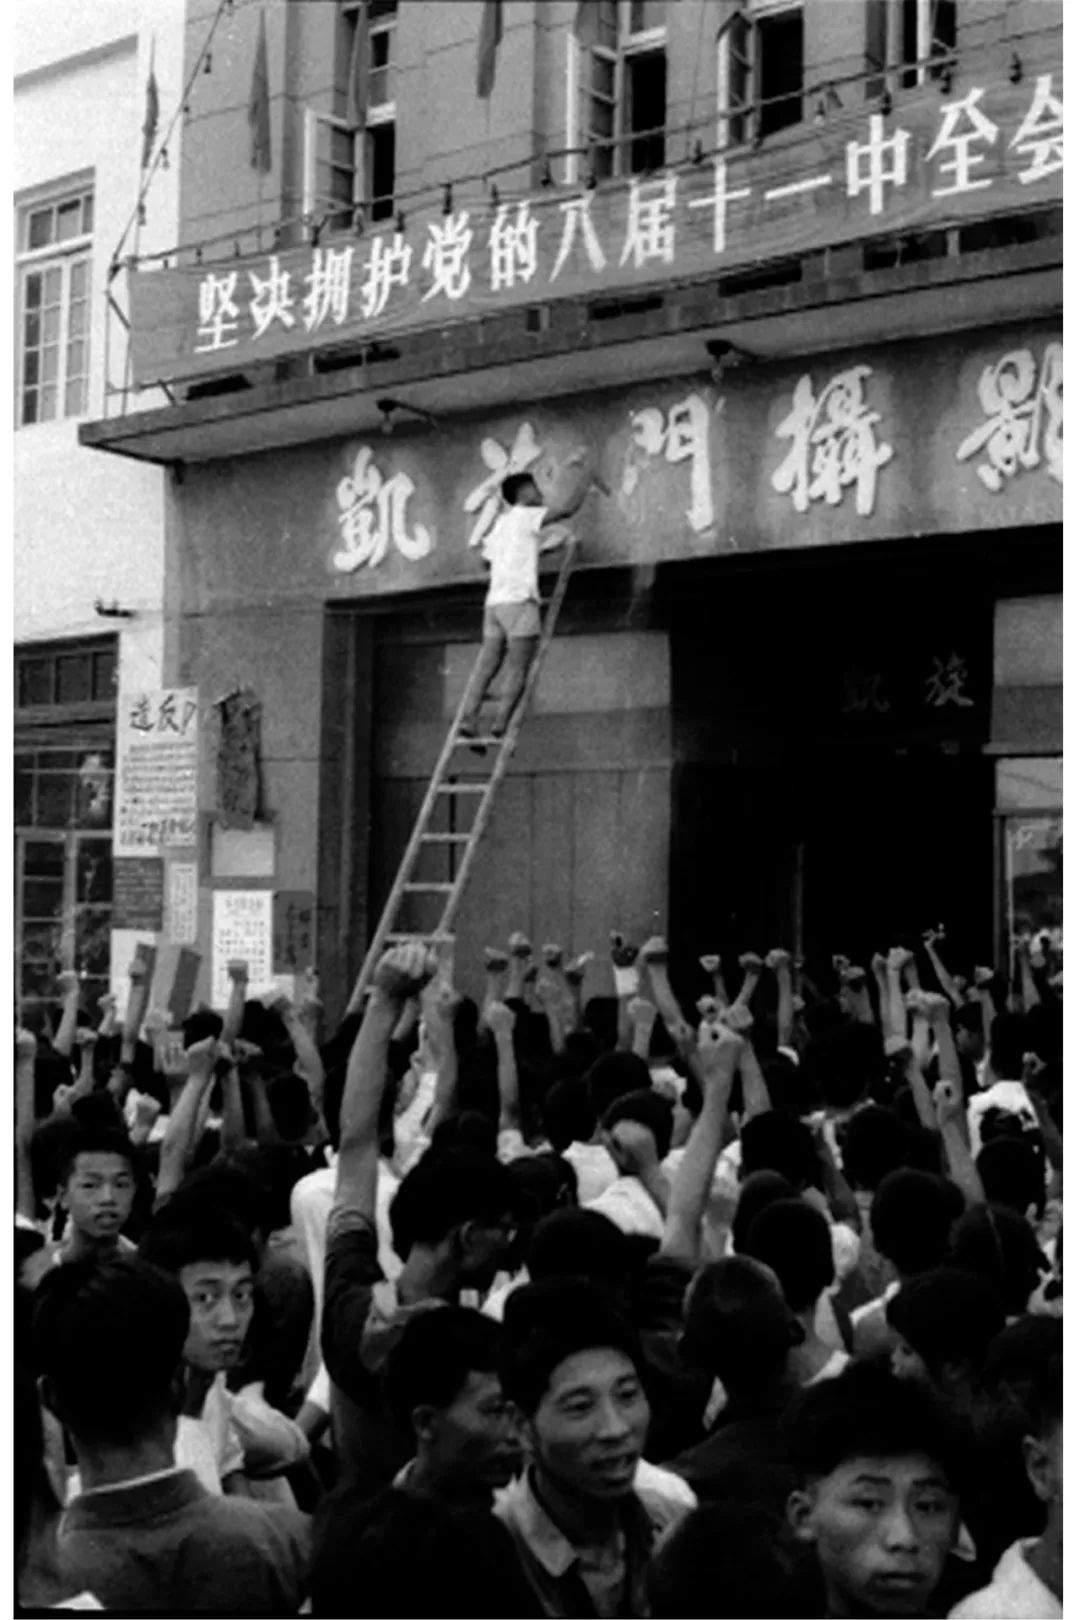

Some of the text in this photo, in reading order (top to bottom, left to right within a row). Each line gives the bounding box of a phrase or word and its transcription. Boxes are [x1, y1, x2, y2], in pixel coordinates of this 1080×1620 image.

[194, 75, 1064, 353] 坚决拥护党的八届十一中全会
